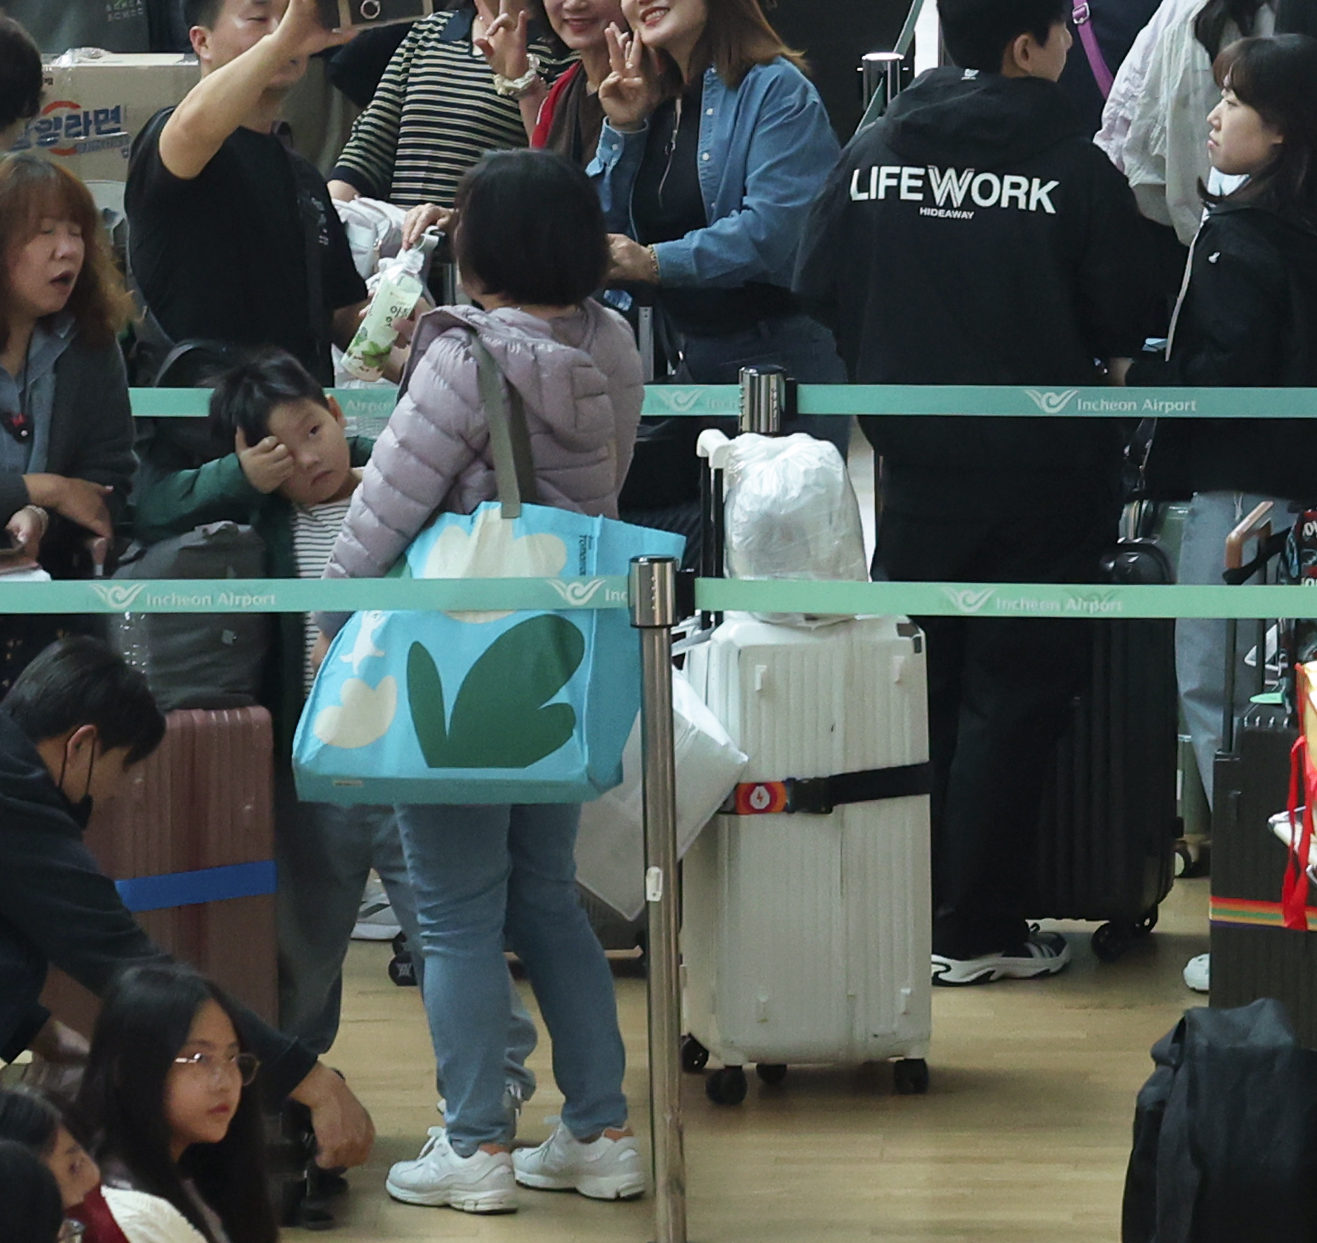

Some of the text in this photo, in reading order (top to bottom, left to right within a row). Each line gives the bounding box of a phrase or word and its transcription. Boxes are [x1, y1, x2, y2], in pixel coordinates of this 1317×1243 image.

[850, 165, 1059, 214] LIFEWORK
[920, 207, 975, 219] HIDEAWAY
[1077, 398, 1197, 415] Incheon Airport
[146, 592, 275, 610] Incheon Airport
[995, 597, 1123, 616] Incheon Airport
